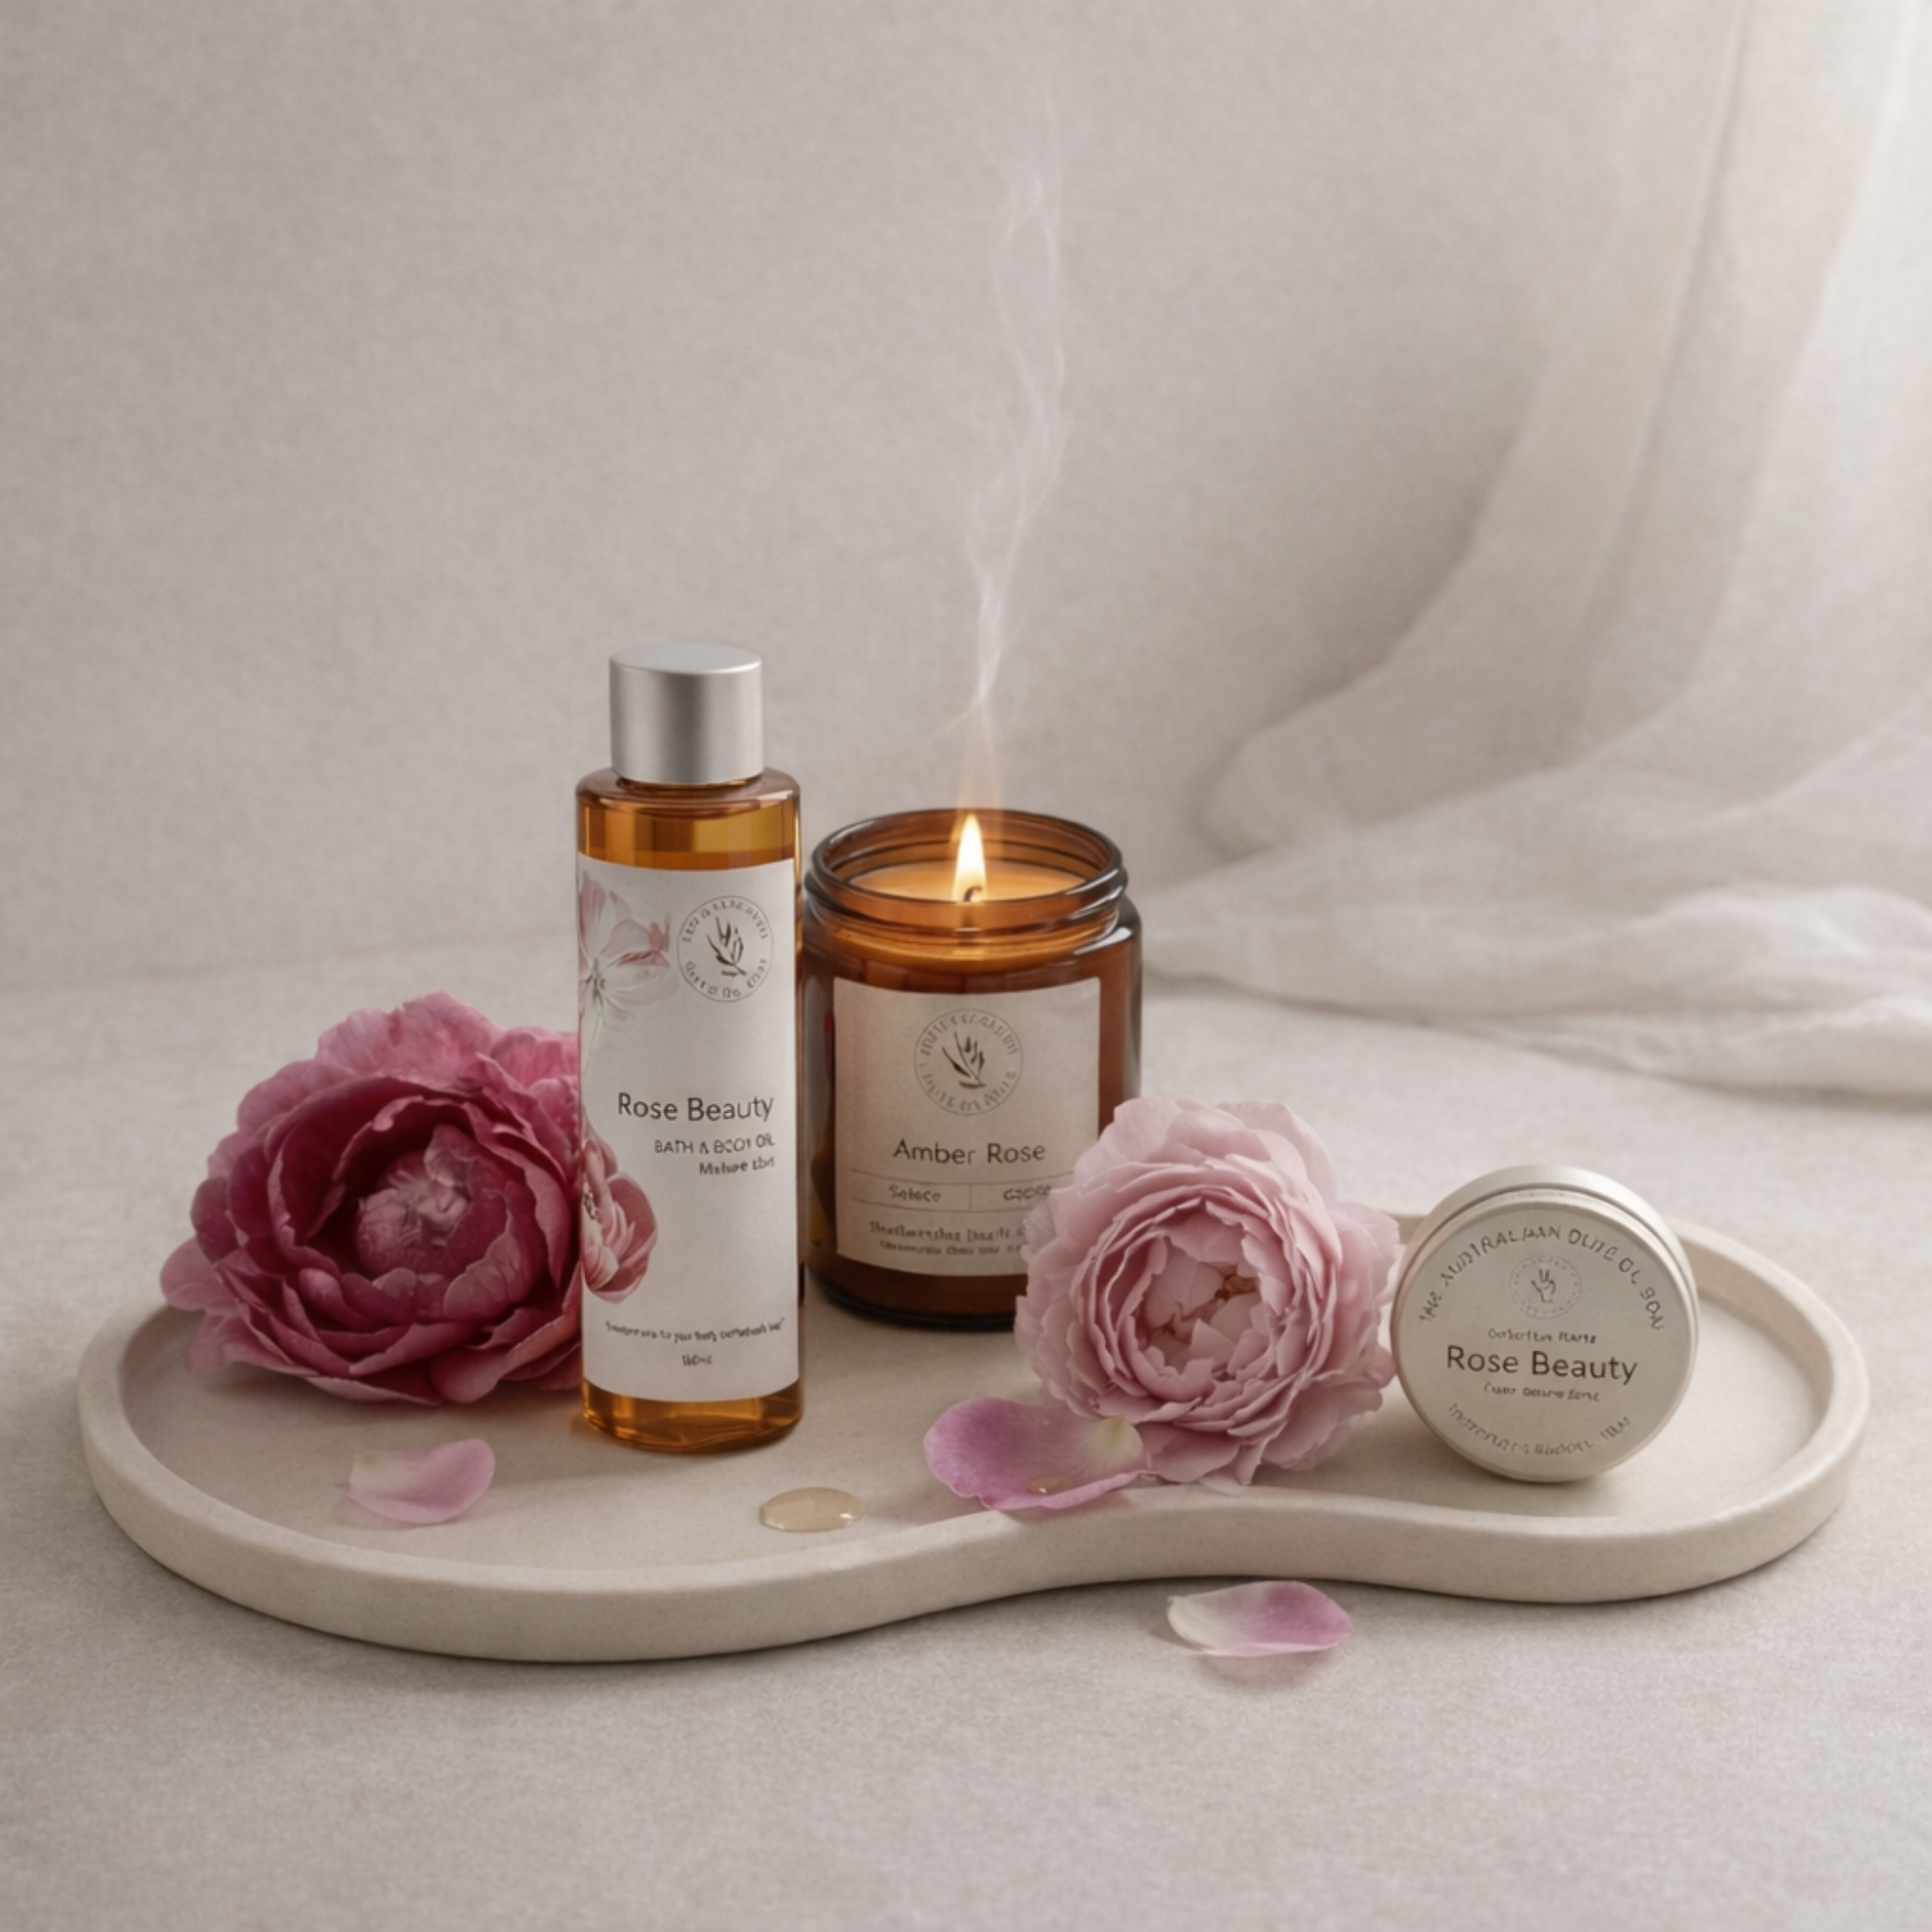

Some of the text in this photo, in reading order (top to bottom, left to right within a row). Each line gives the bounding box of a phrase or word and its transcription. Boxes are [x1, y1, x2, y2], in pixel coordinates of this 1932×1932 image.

[618, 1091, 774, 1123] Rose Beauty
[654, 1139, 694, 1155] BATH
[893, 1139, 1046, 1166] Amber Rose
[1446, 1344, 1638, 1386] Rose Beauty
